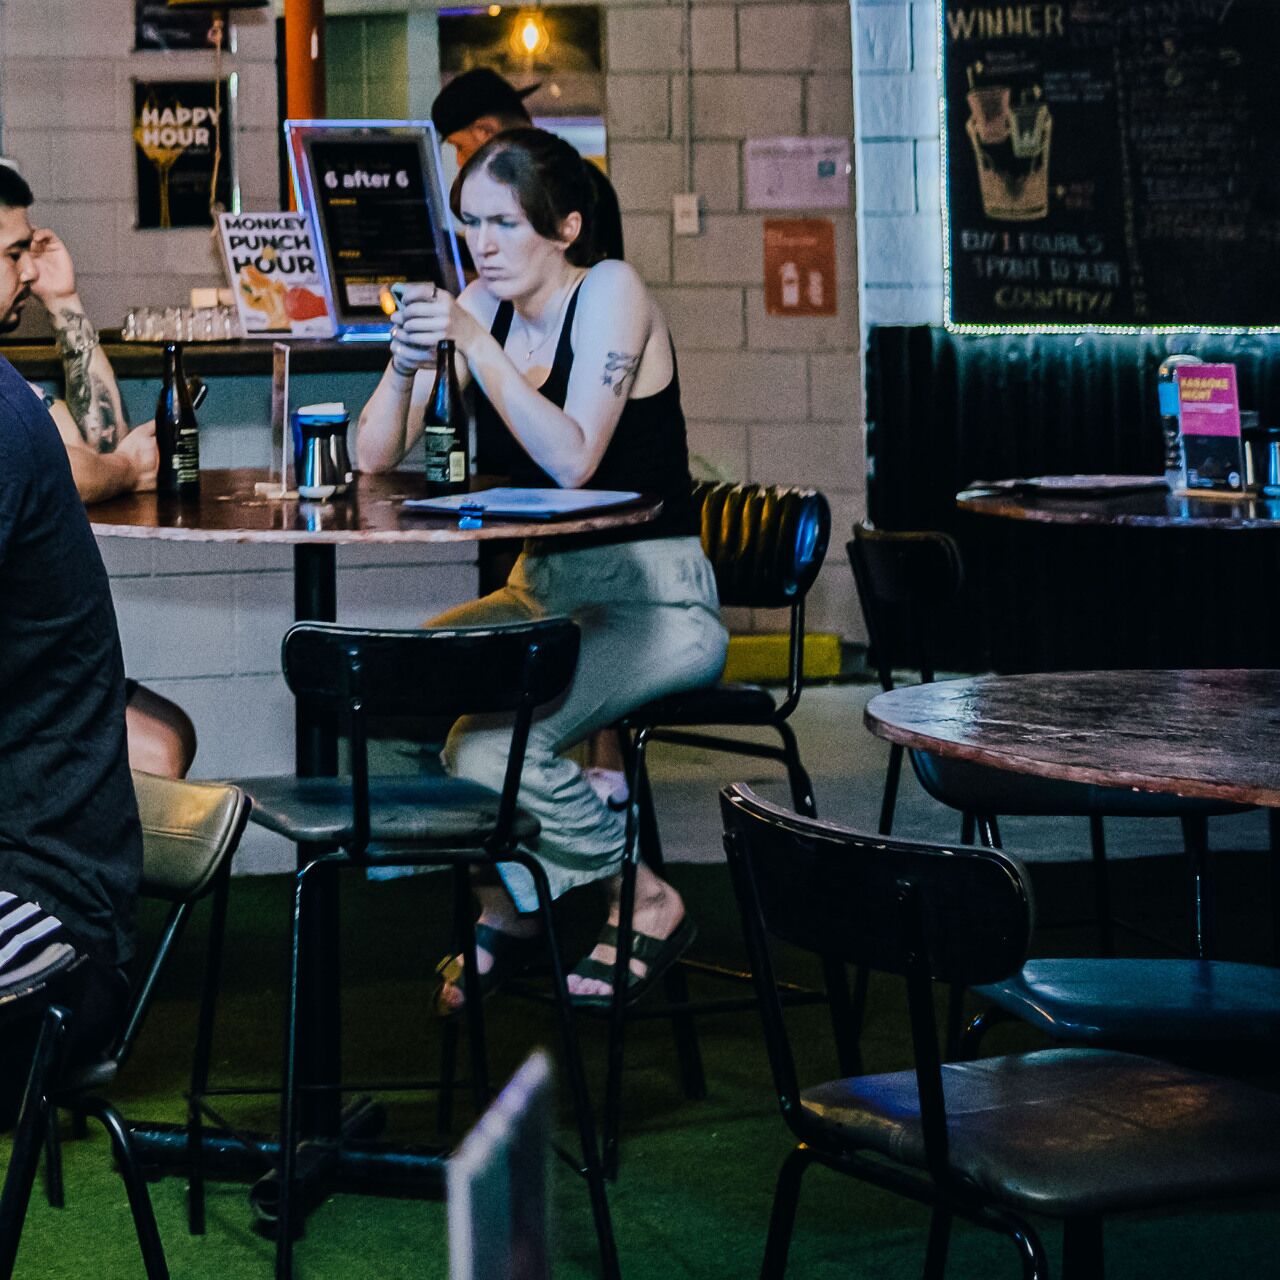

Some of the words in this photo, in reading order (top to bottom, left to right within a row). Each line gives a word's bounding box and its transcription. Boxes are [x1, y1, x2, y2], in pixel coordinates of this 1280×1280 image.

[947, 5, 1064, 40] WINNER
[142, 107, 222, 126] HAPPY
[143, 127, 209, 147] HOUR
[325, 171, 338, 188] 6
[343, 170, 390, 188] after
[396, 171, 409, 188] 6
[225, 218, 306, 231] MONKEY
[229, 235, 311, 250] PUNCH
[232, 256, 315, 274] HOUR
